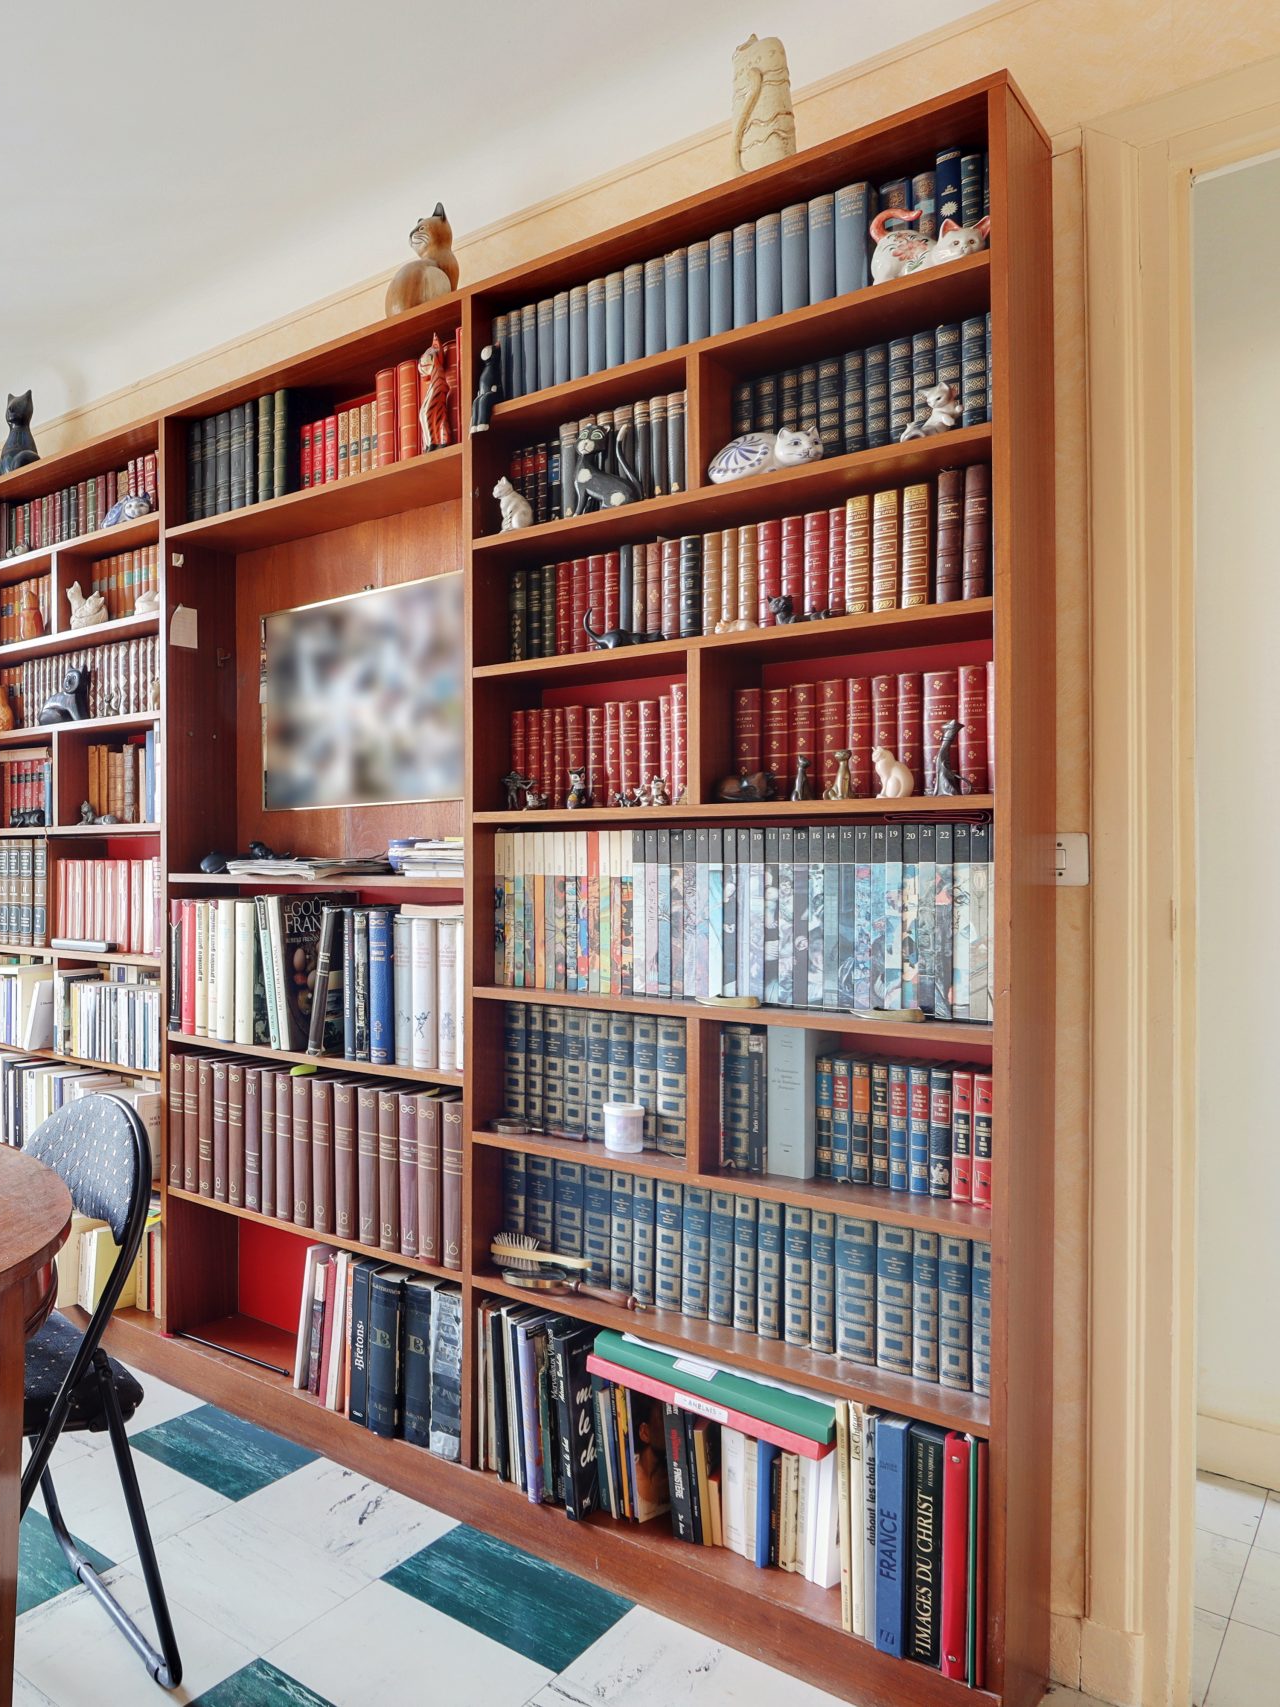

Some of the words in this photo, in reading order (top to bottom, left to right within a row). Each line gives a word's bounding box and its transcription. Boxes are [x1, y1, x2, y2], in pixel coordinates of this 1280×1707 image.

[753, 833, 762, 841] 10
[858, 832, 867, 840] 17
[874, 832, 883, 840] 18
[889, 830, 898, 838] 19
[906, 832, 916, 840] 20
[291, 896, 330, 916] GOÛT
[284, 913, 321, 934] FRAN
[338, 1211, 348, 1225] 18
[361, 1217, 372, 1230] 17
[382, 1224, 392, 1237] 13
[403, 1230, 414, 1242] 14
[422, 1235, 433, 1250] 15
[445, 1240, 458, 1254] 16
[354, 1324, 364, 1368] Bretons
[547, 1328, 555, 1357] Villages
[578, 1408, 591, 1433] le
[851, 1445, 861, 1461] Les
[866, 1456, 876, 1486] chats
[673, 1467, 685, 1499] FINISTÈRE
[866, 1488, 876, 1504] les
[866, 1508, 876, 1546] dubout
[917, 1488, 933, 1552] CHRIST
[879, 1508, 898, 1581] FRANCE
[915, 1555, 932, 1583] DU
[915, 1586, 932, 1649] IMAGES
